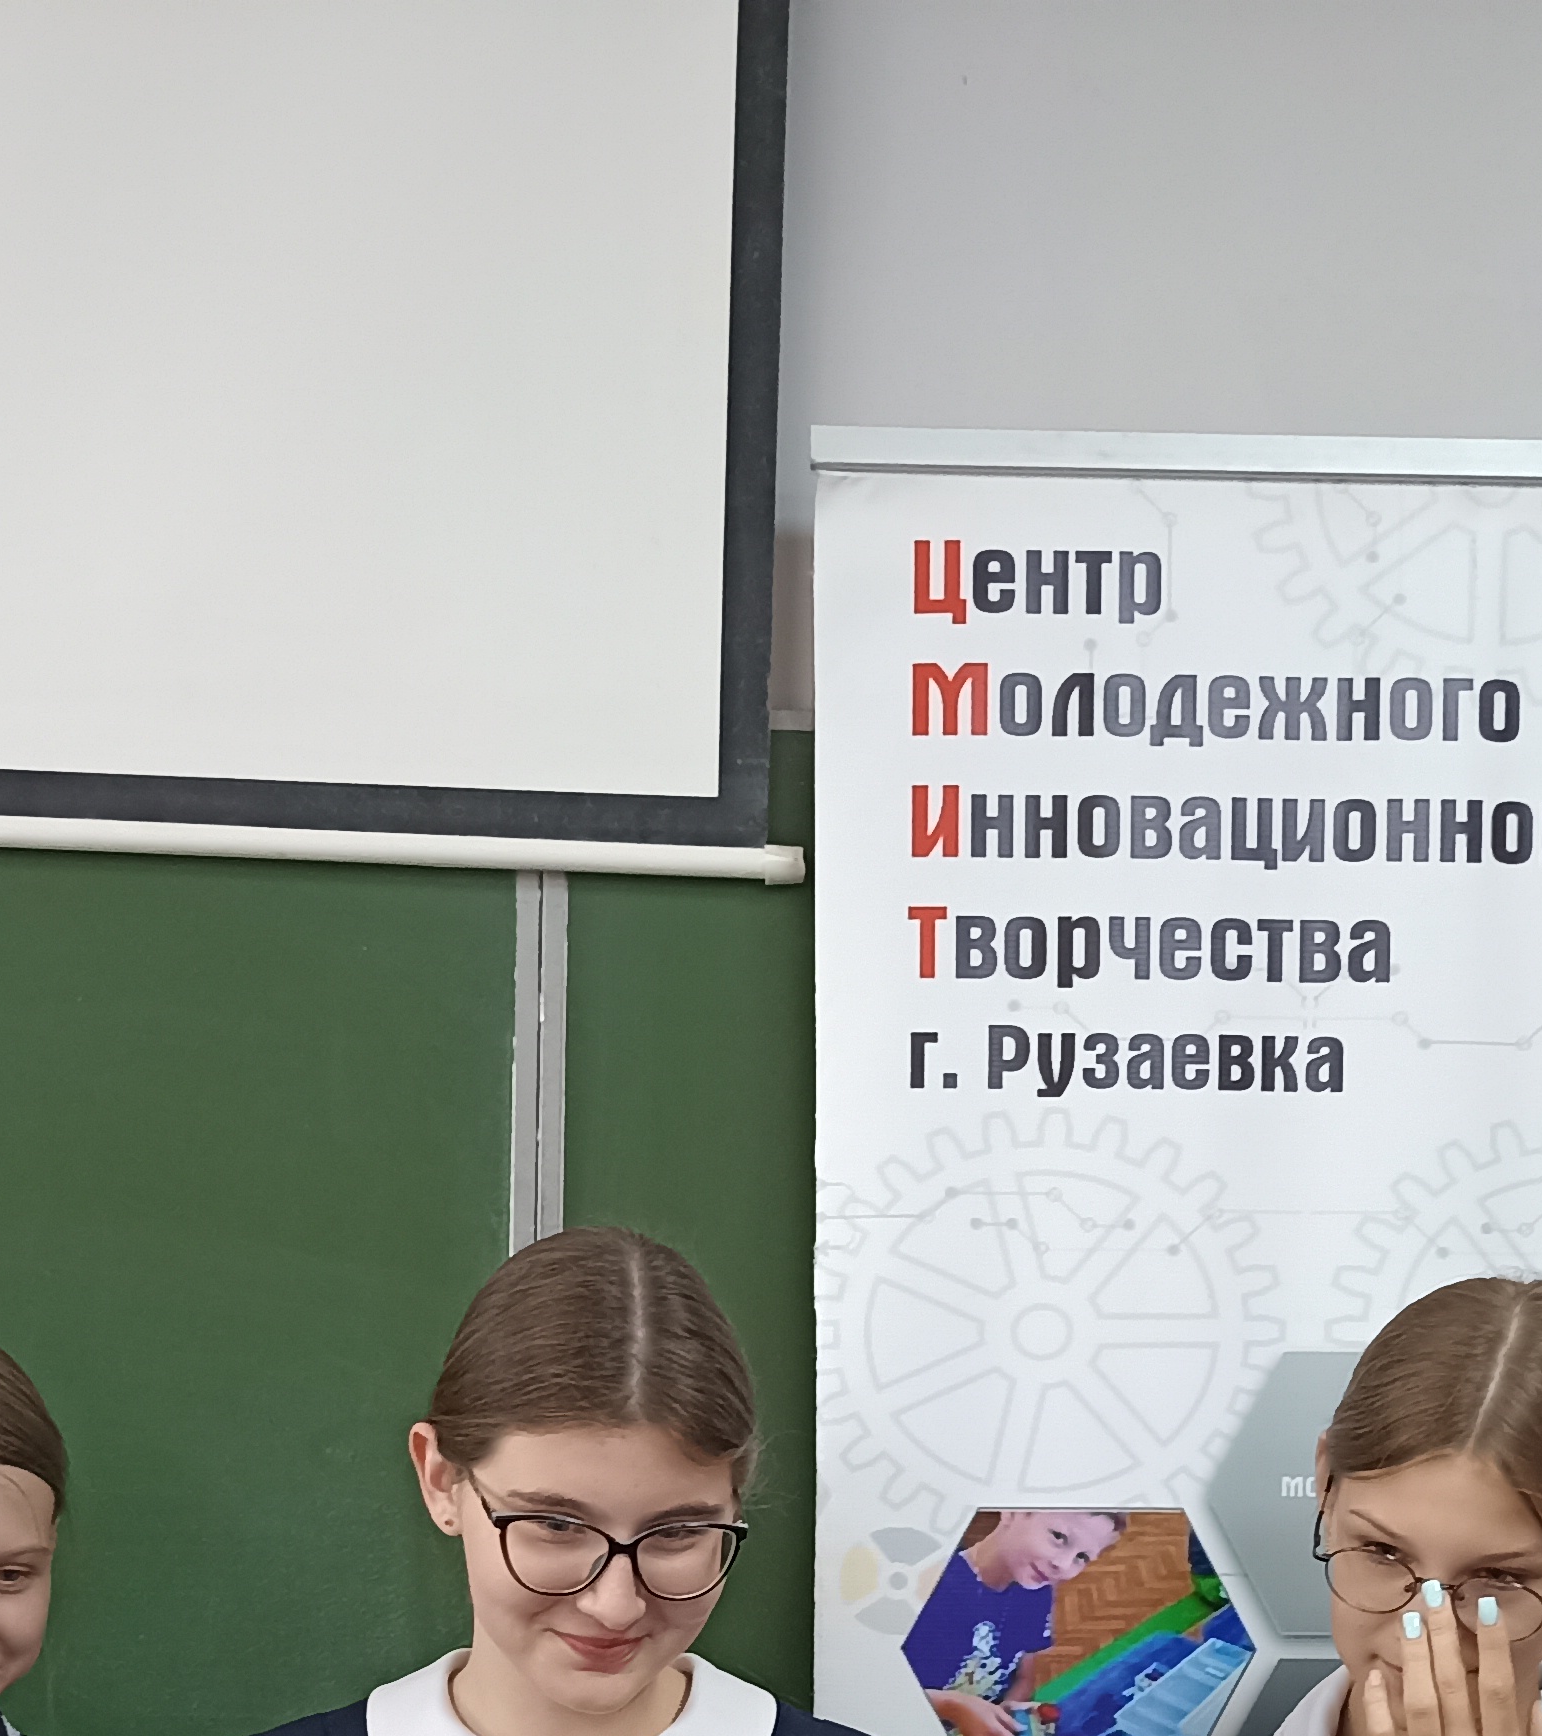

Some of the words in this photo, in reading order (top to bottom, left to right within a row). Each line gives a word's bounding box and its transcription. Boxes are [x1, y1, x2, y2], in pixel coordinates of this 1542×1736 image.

[914, 540, 1164, 625] Центр
[912, 663, 1522, 748] Молодежного
[908, 906, 1392, 988] Творчества
[909, 1028, 959, 1090] г.
[986, 1024, 1345, 1098] Рузаевка
